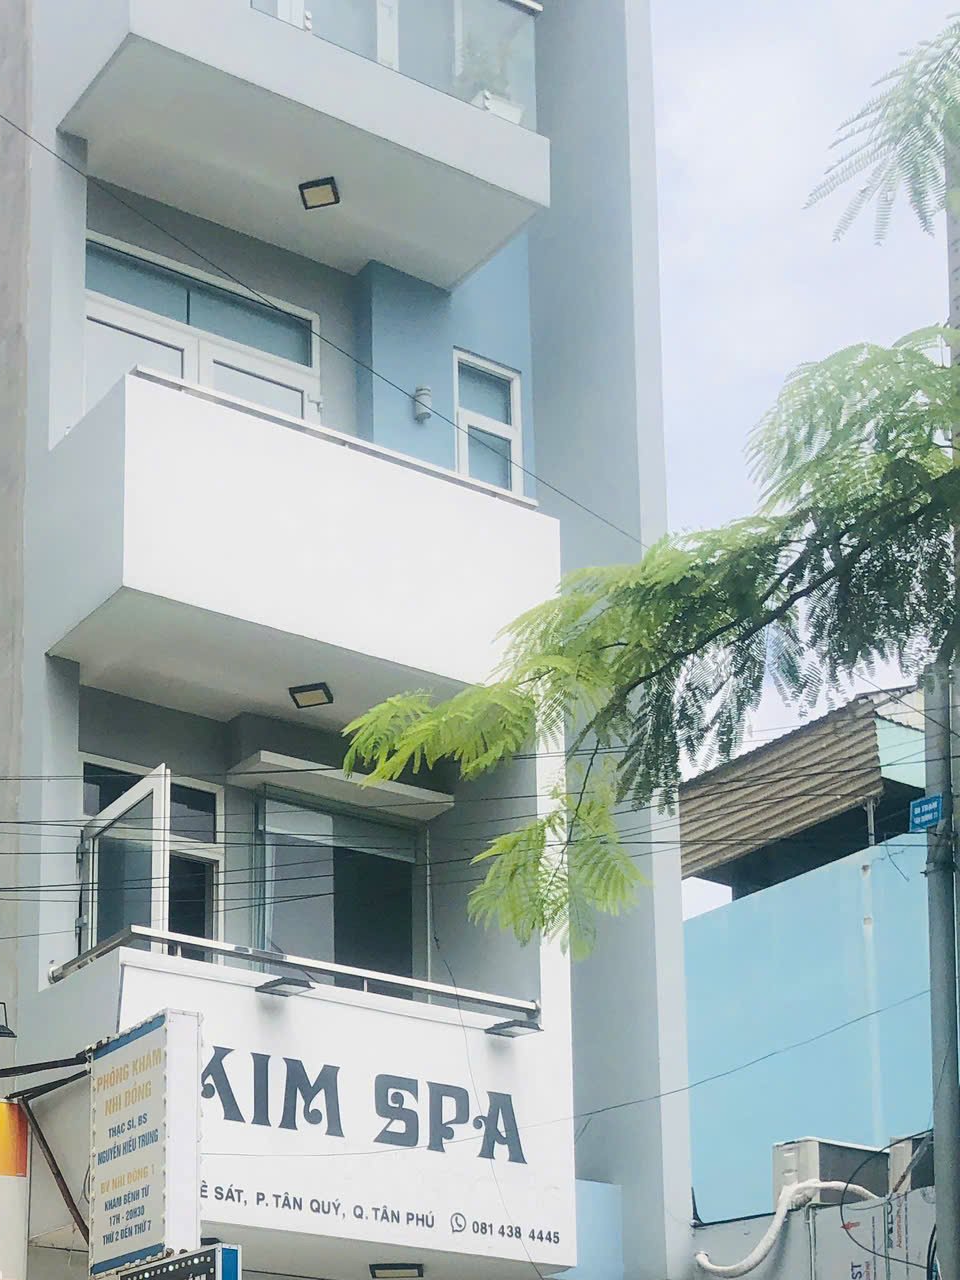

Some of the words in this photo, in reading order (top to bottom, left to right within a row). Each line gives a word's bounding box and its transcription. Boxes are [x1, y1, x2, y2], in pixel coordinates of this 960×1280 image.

[138, 1113, 148, 1126] BS
[373, 1073, 527, 1165] SPA
[138, 1128, 159, 1150] TRUNG
[214, 1183, 248, 1207] SÁT,
[256, 1192, 269, 1207] P.
[272, 1192, 303, 1211] TÂN
[310, 1197, 346, 1219] QUÝ,
[353, 1204, 369, 1221] Q.
[372, 1204, 400, 1224] TÂN
[407, 1211, 435, 1229] PHÚ
[472, 1220, 494, 1236] 081
[498, 1223, 522, 1239] 438
[528, 1228, 561, 1244] 4445
